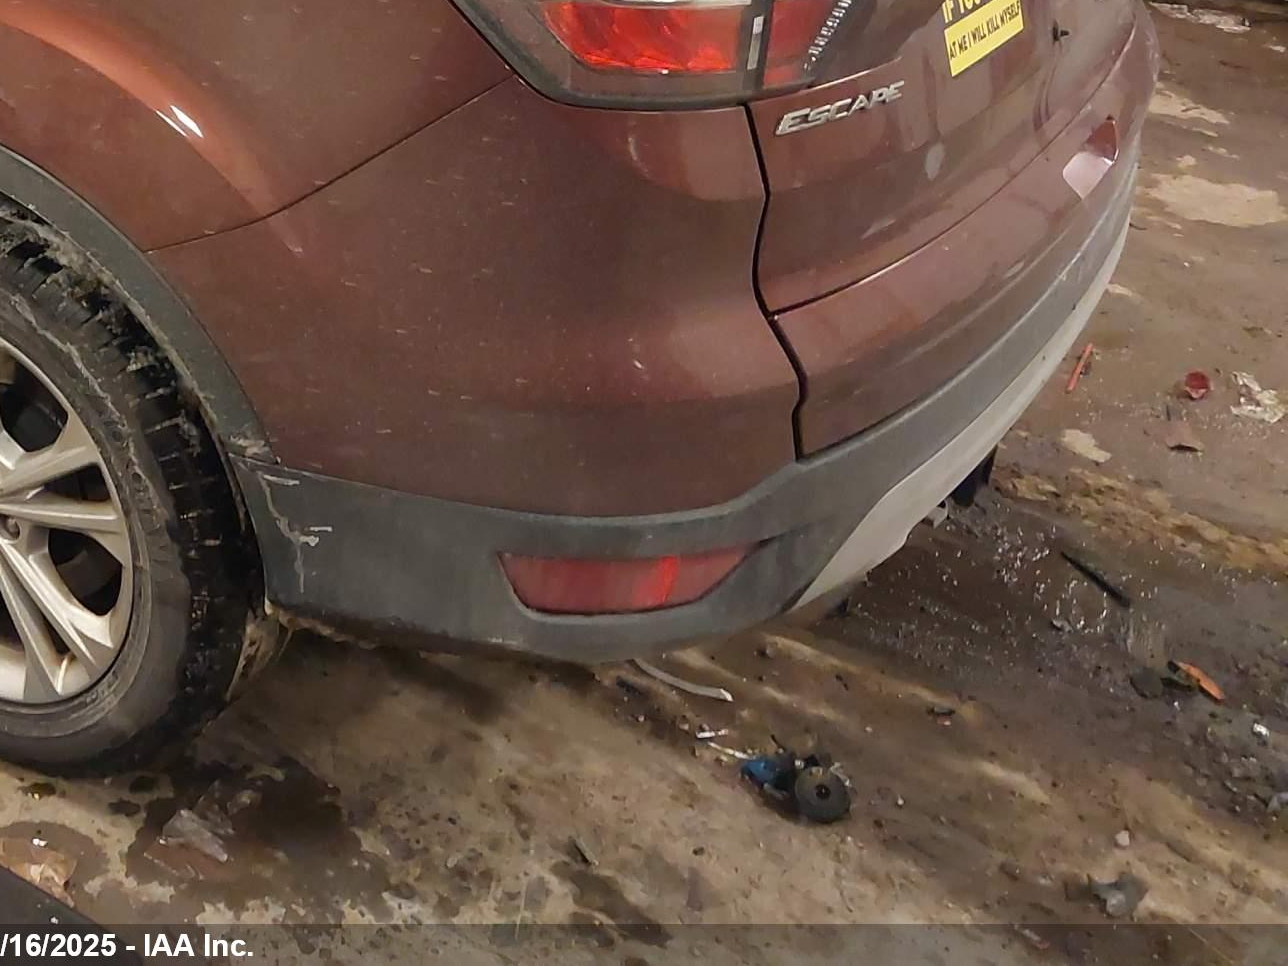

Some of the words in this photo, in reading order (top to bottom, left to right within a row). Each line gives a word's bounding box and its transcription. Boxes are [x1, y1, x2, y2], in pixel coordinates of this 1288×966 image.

[949, 41, 957, 59] AT
[957, 34, 968, 54] ME
[970, 24, 987, 43] WILL
[986, 14, 1000, 35] KILL
[998, 0, 1020, 27] MYSELF
[775, 80, 905, 136] ESCAPE
